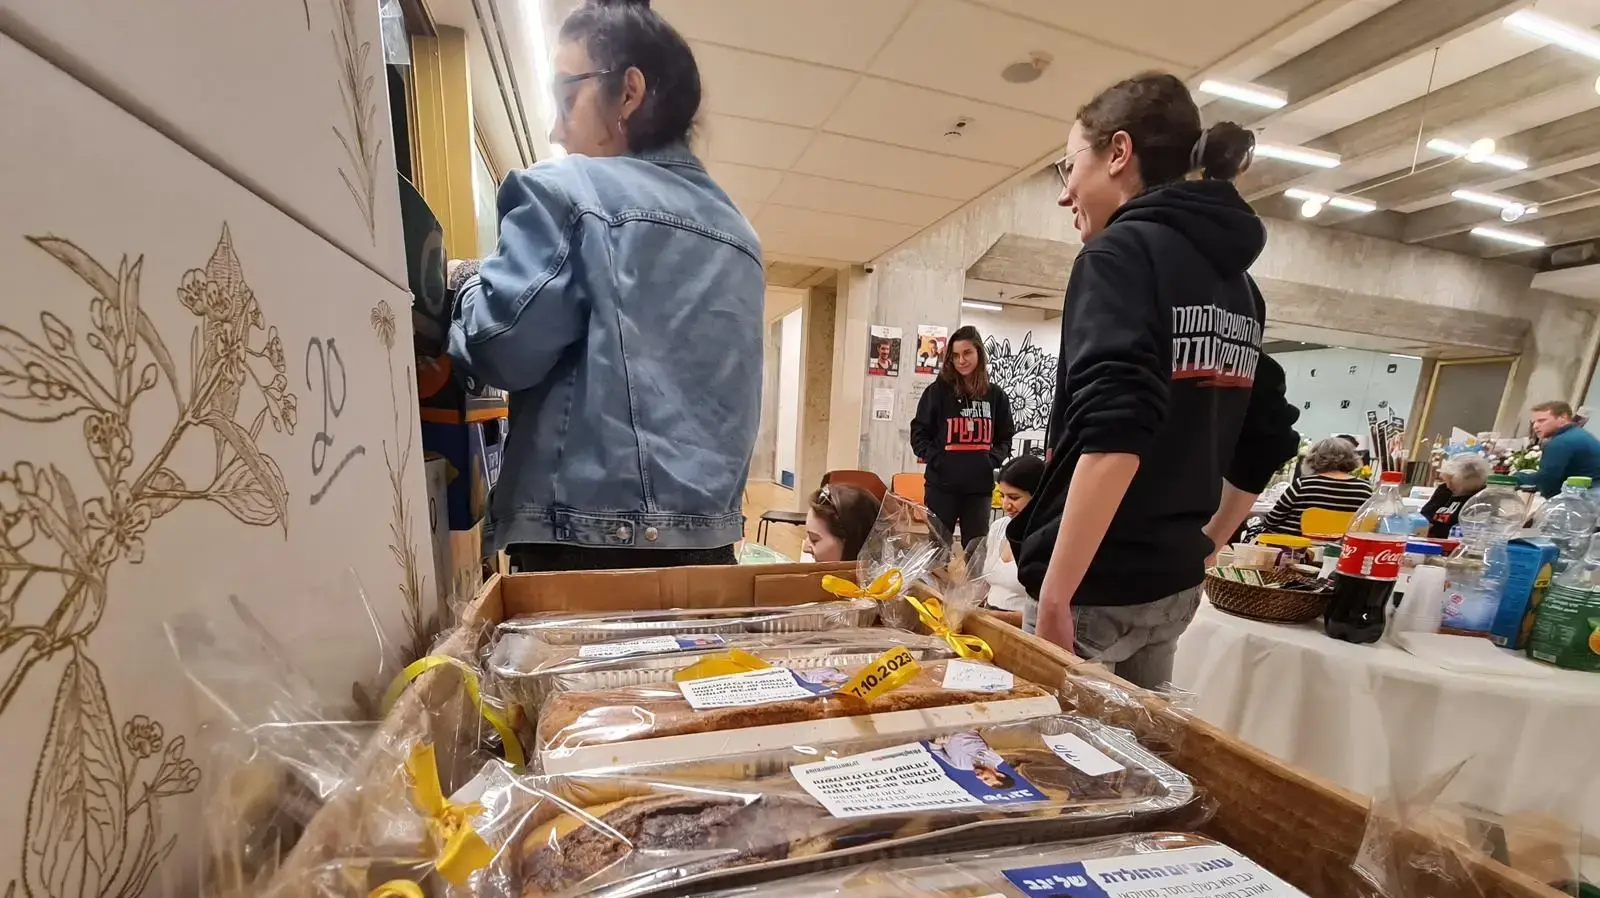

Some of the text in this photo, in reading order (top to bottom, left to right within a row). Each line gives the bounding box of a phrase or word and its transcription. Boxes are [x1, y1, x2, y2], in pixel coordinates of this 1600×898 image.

[946, 417, 992, 443] עכשיו
[851, 652, 912, 697] 7.10.2023
[1099, 858, 1234, 884] עוגת יום ההולדת
[1236, 872, 1254, 882] יגב
[1023, 875, 1088, 890] של יגב
[1191, 880, 1221, 895] בשלן
[1219, 876, 1241, 888] הוא
[1238, 883, 1273, 898] ואוהב
